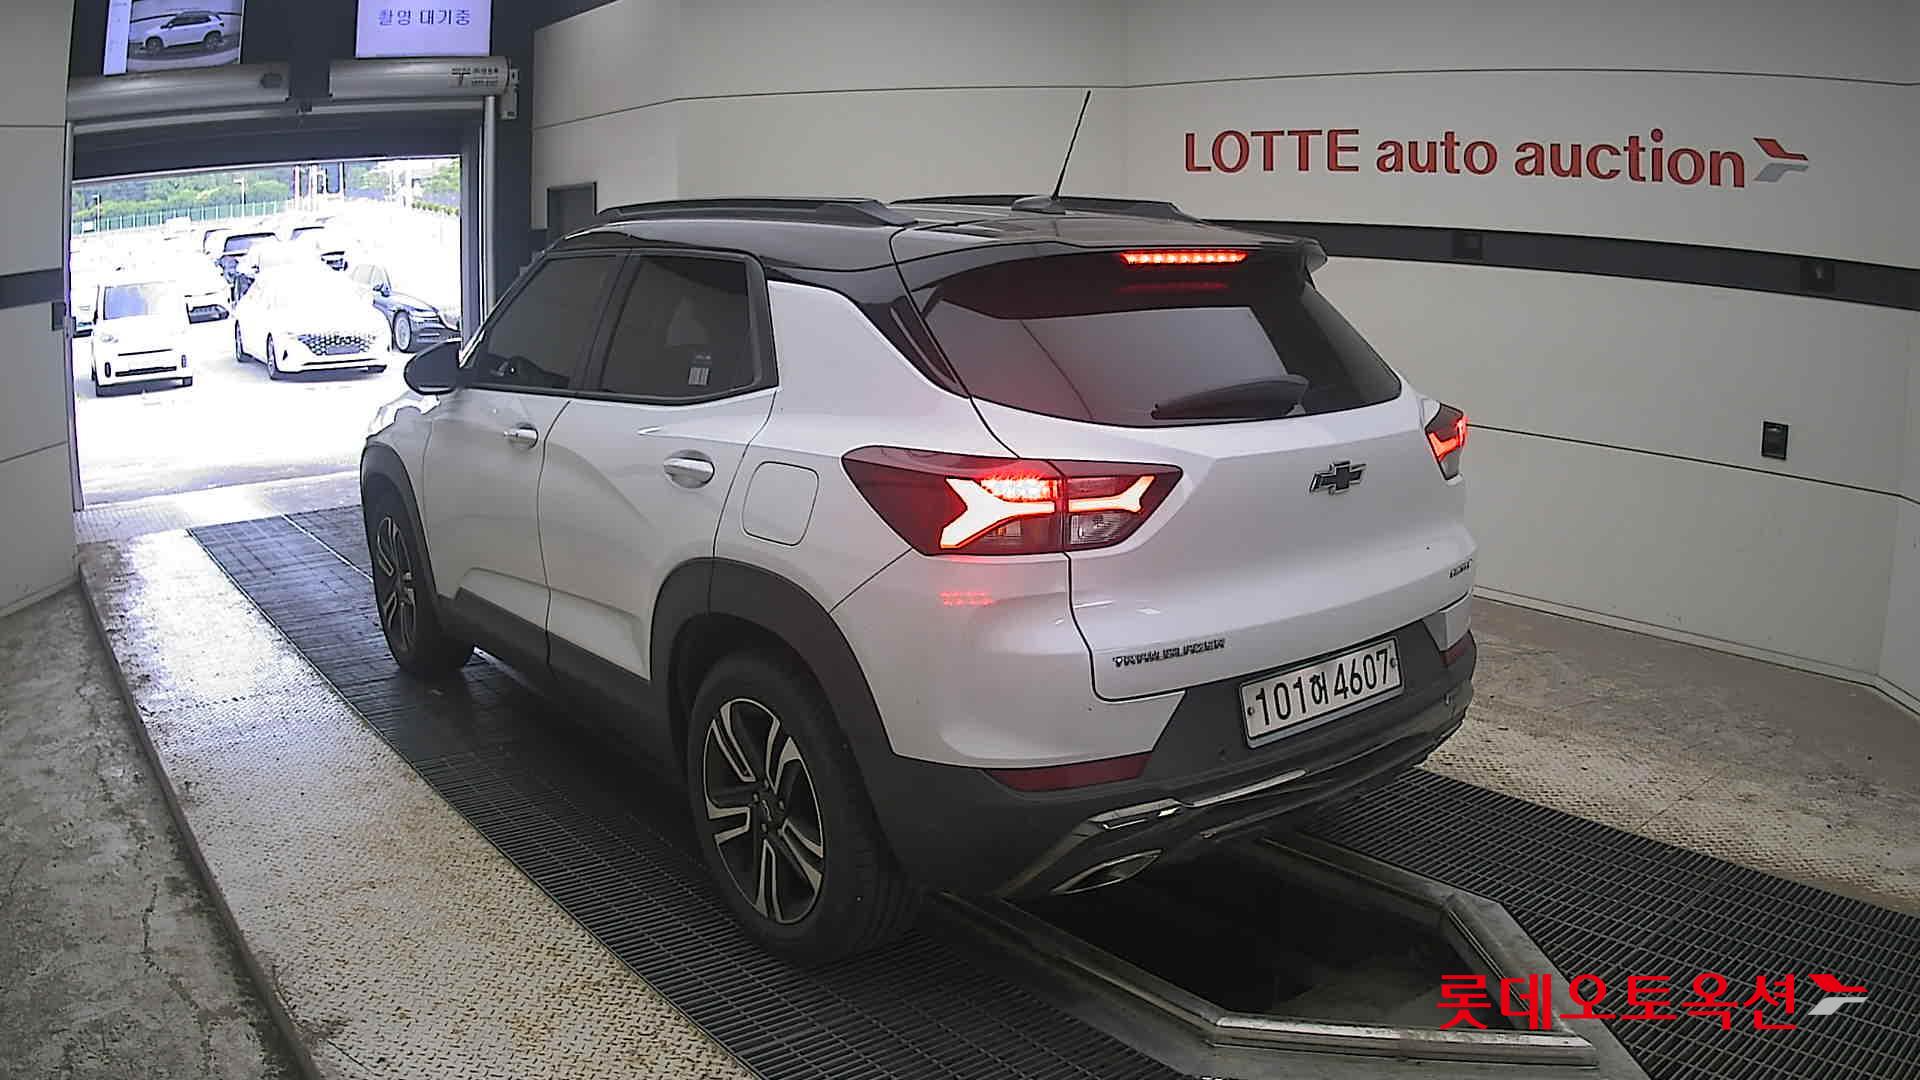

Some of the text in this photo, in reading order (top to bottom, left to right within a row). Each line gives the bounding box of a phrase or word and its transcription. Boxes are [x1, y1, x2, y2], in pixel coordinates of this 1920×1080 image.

[420, 8, 471, 26] 대기중
[1185, 128, 1745, 188] LOTTE auto auction
